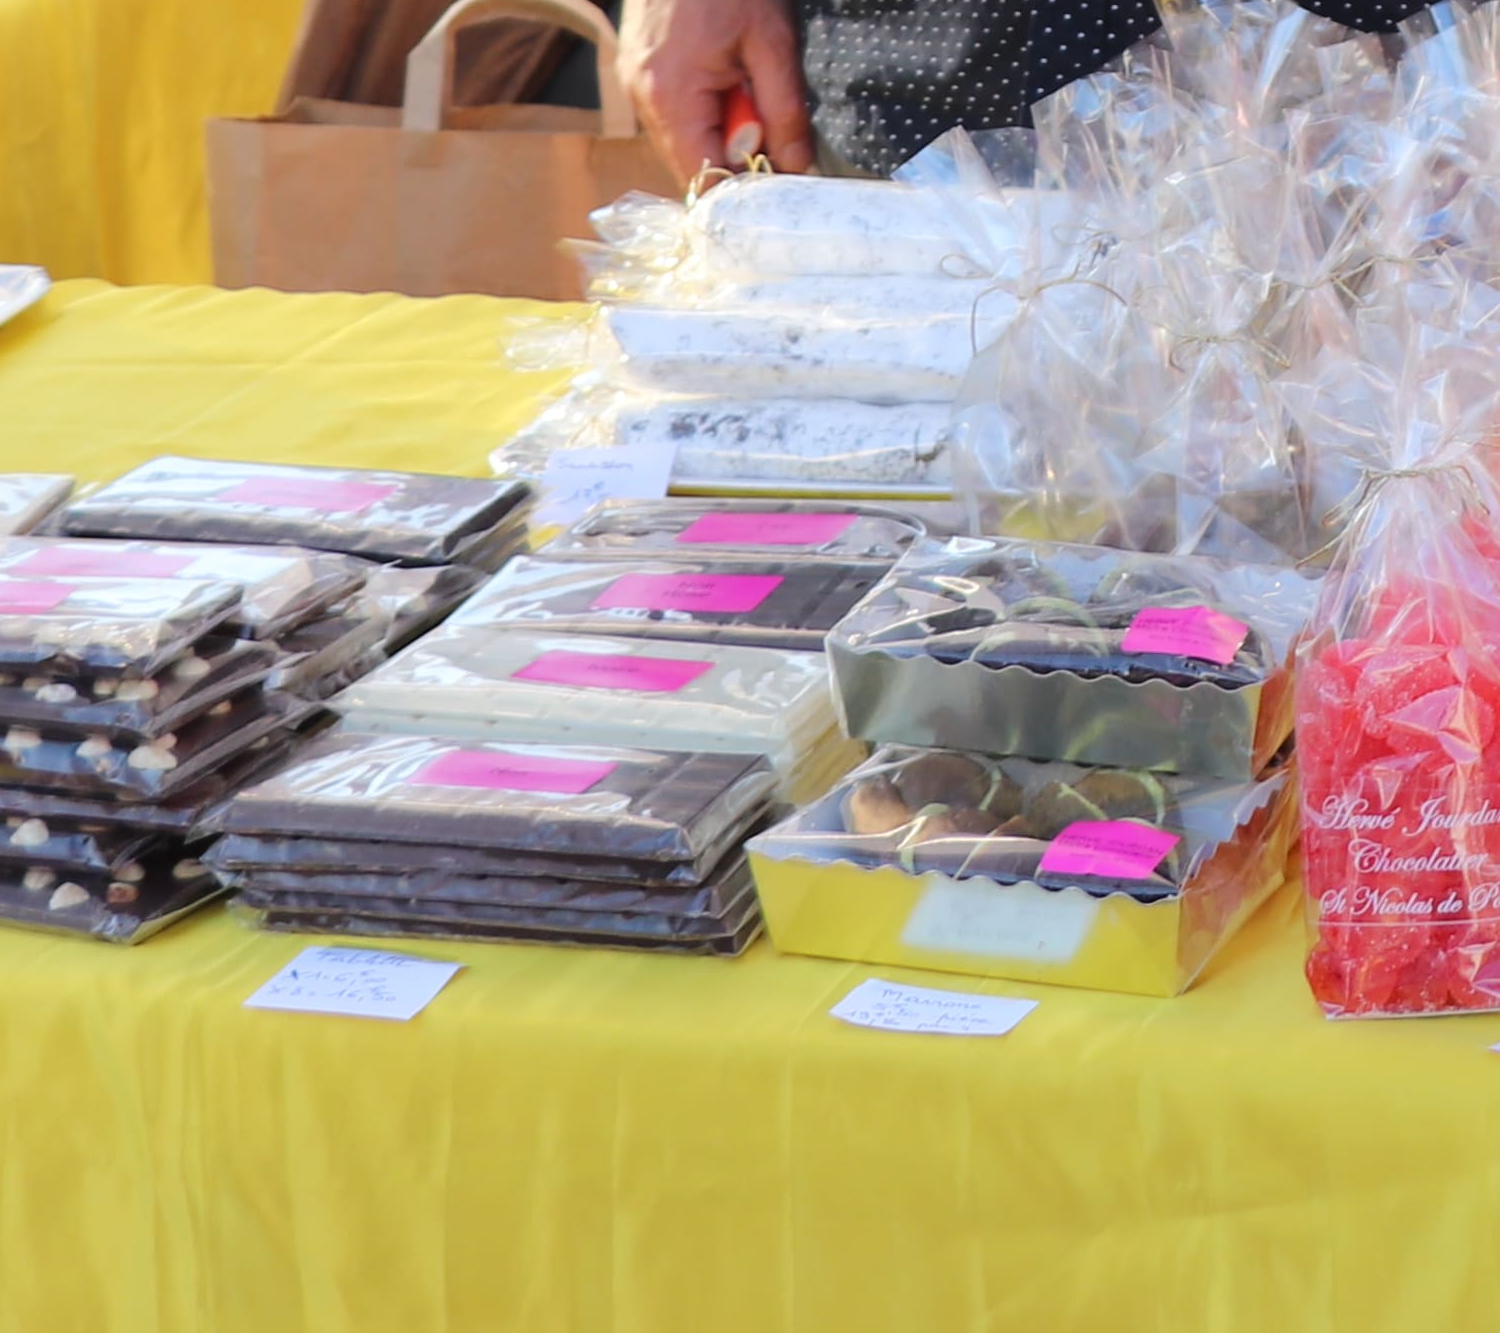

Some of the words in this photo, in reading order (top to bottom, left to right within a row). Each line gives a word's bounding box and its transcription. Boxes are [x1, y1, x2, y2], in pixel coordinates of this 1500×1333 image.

[1319, 795, 1401, 831] Hervé
[1348, 837, 1488, 874] Chocolatier
[1318, 888, 1347, 915] St
[1349, 885, 1434, 917] Nicolas
[1436, 892, 1463, 915] de
